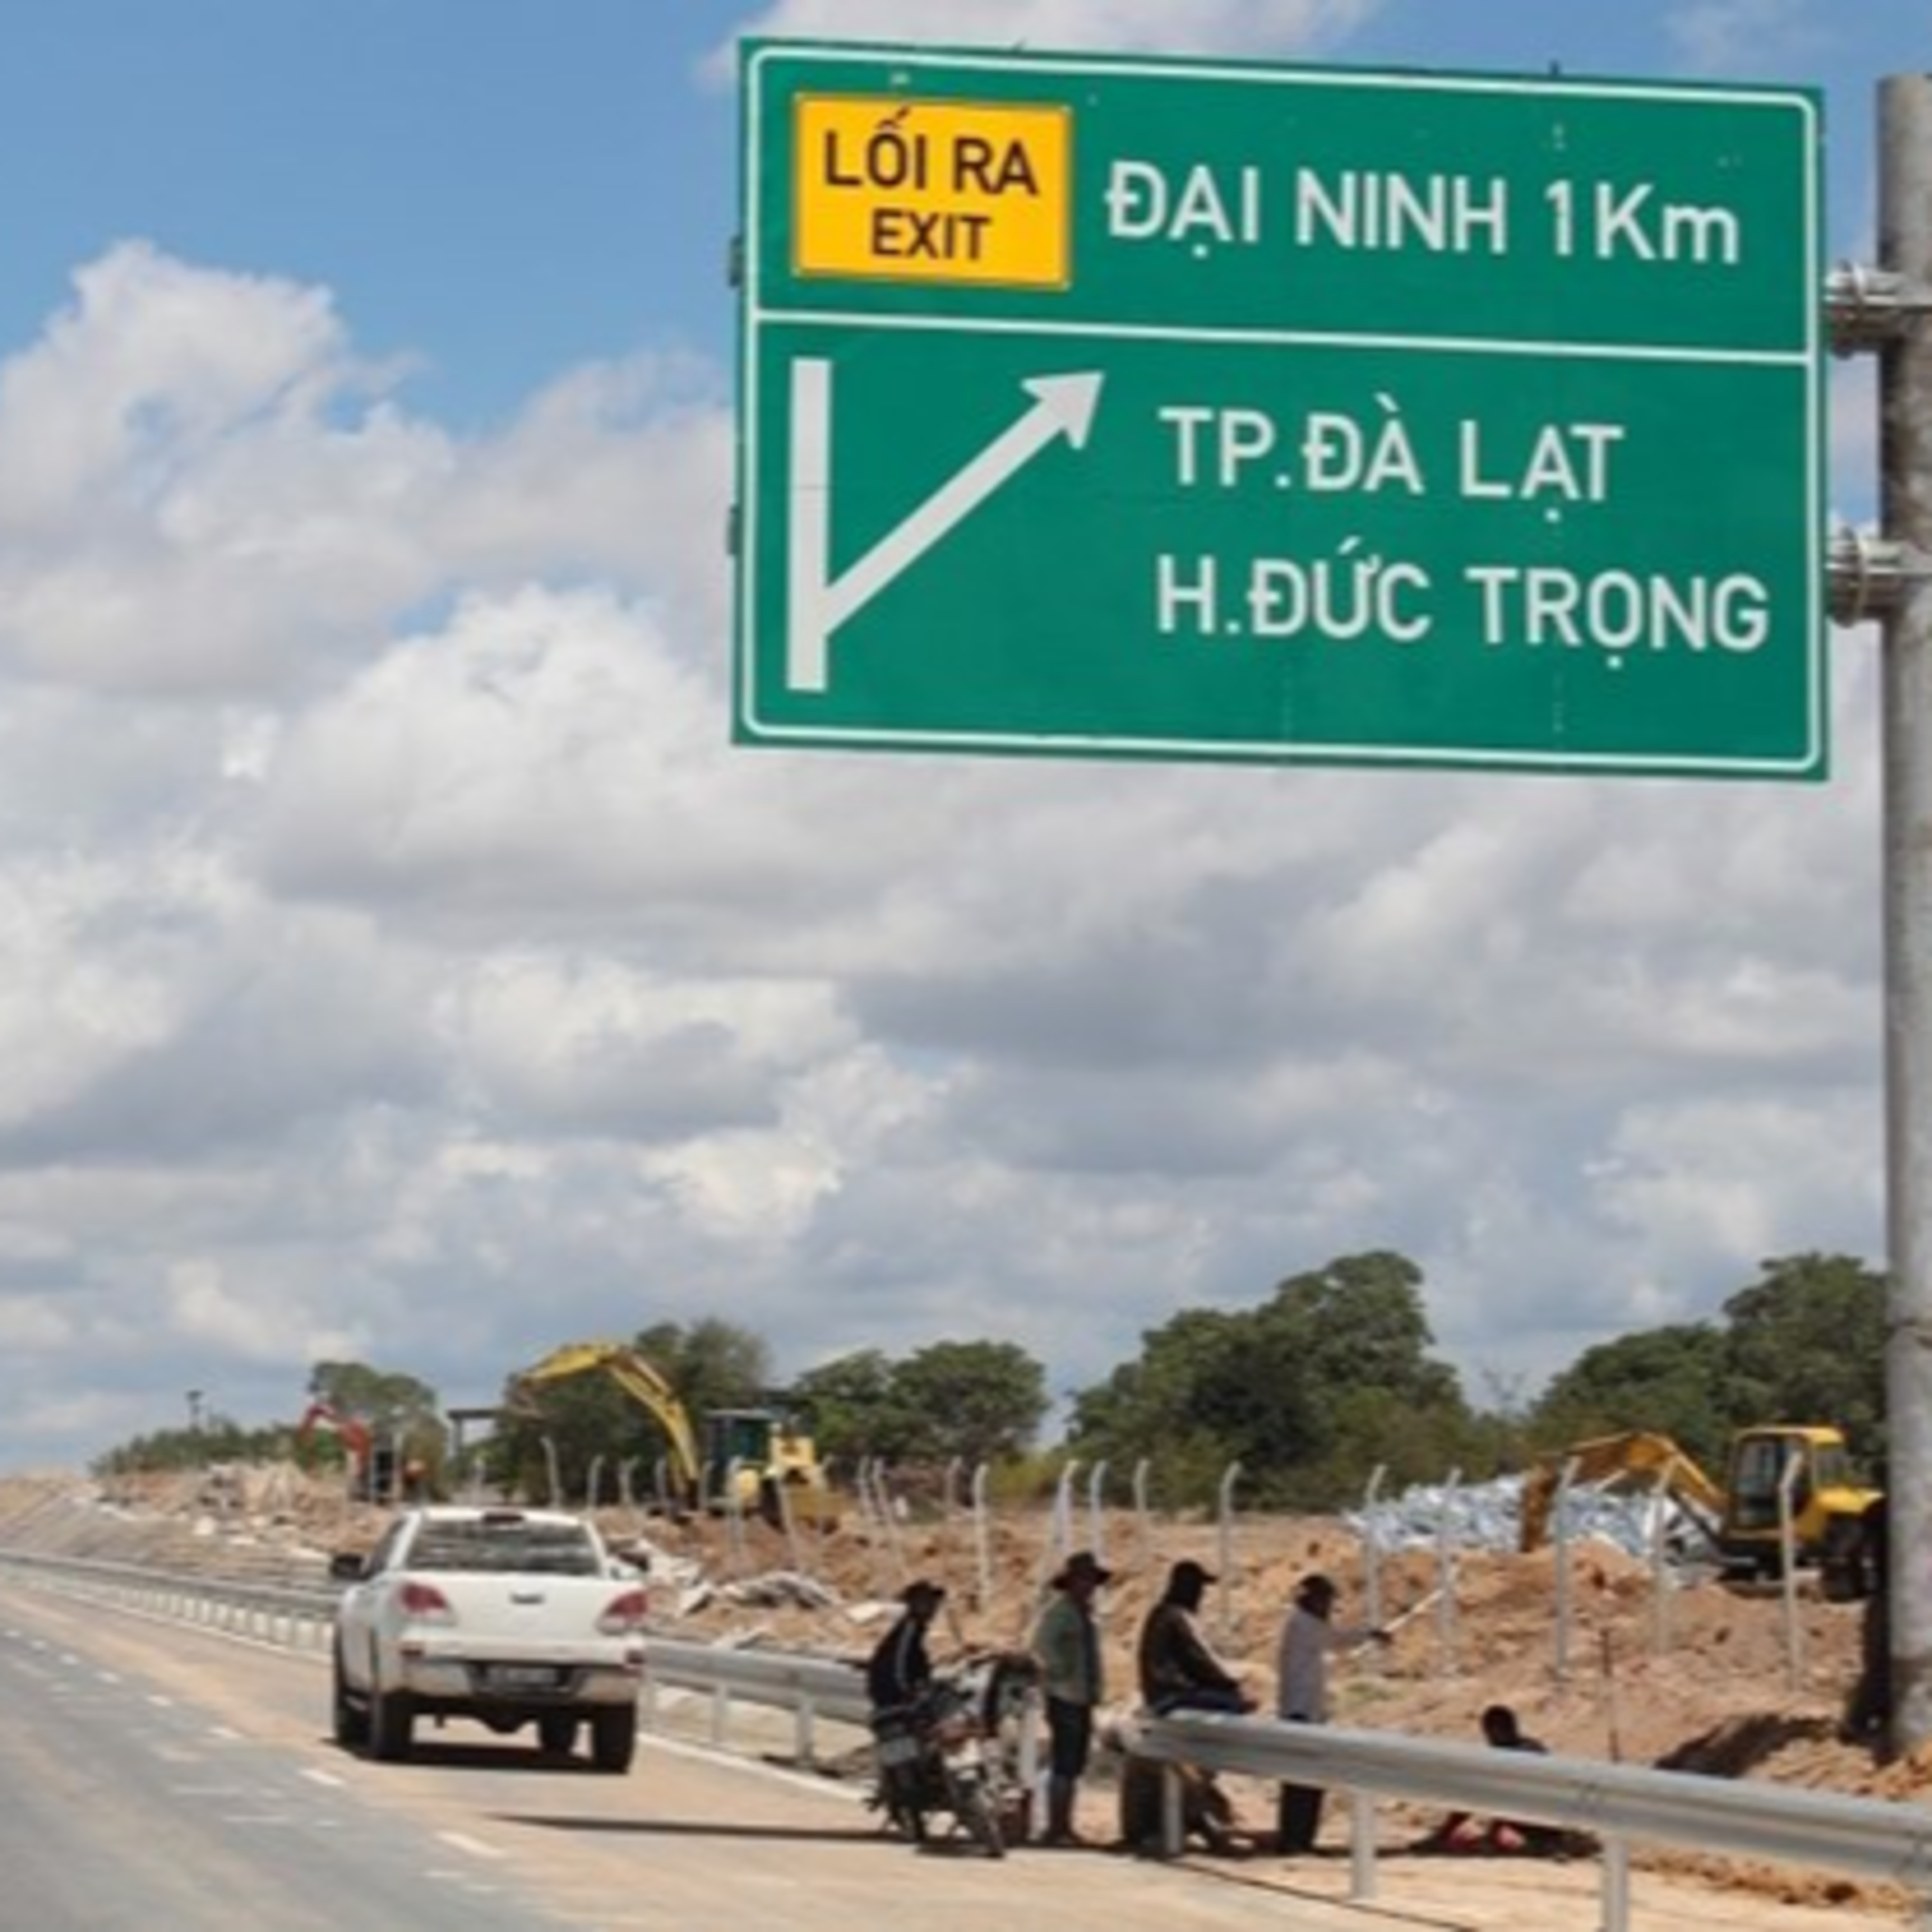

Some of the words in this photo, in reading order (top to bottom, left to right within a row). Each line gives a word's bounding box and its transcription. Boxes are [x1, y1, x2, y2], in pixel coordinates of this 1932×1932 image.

[824, 104, 927, 191] LỐI
[952, 135, 1039, 196] RA
[871, 207, 992, 260] EXIT
[1105, 160, 1258, 256] ĐẠI
[1297, 169, 1506, 253] NINH
[1160, 393, 1423, 493] TP.ĐÀ
[1461, 420, 1624, 520] LẠT
[1159, 536, 1430, 641] H.ĐỨC
[1466, 567, 1768, 667] TRỌNG
